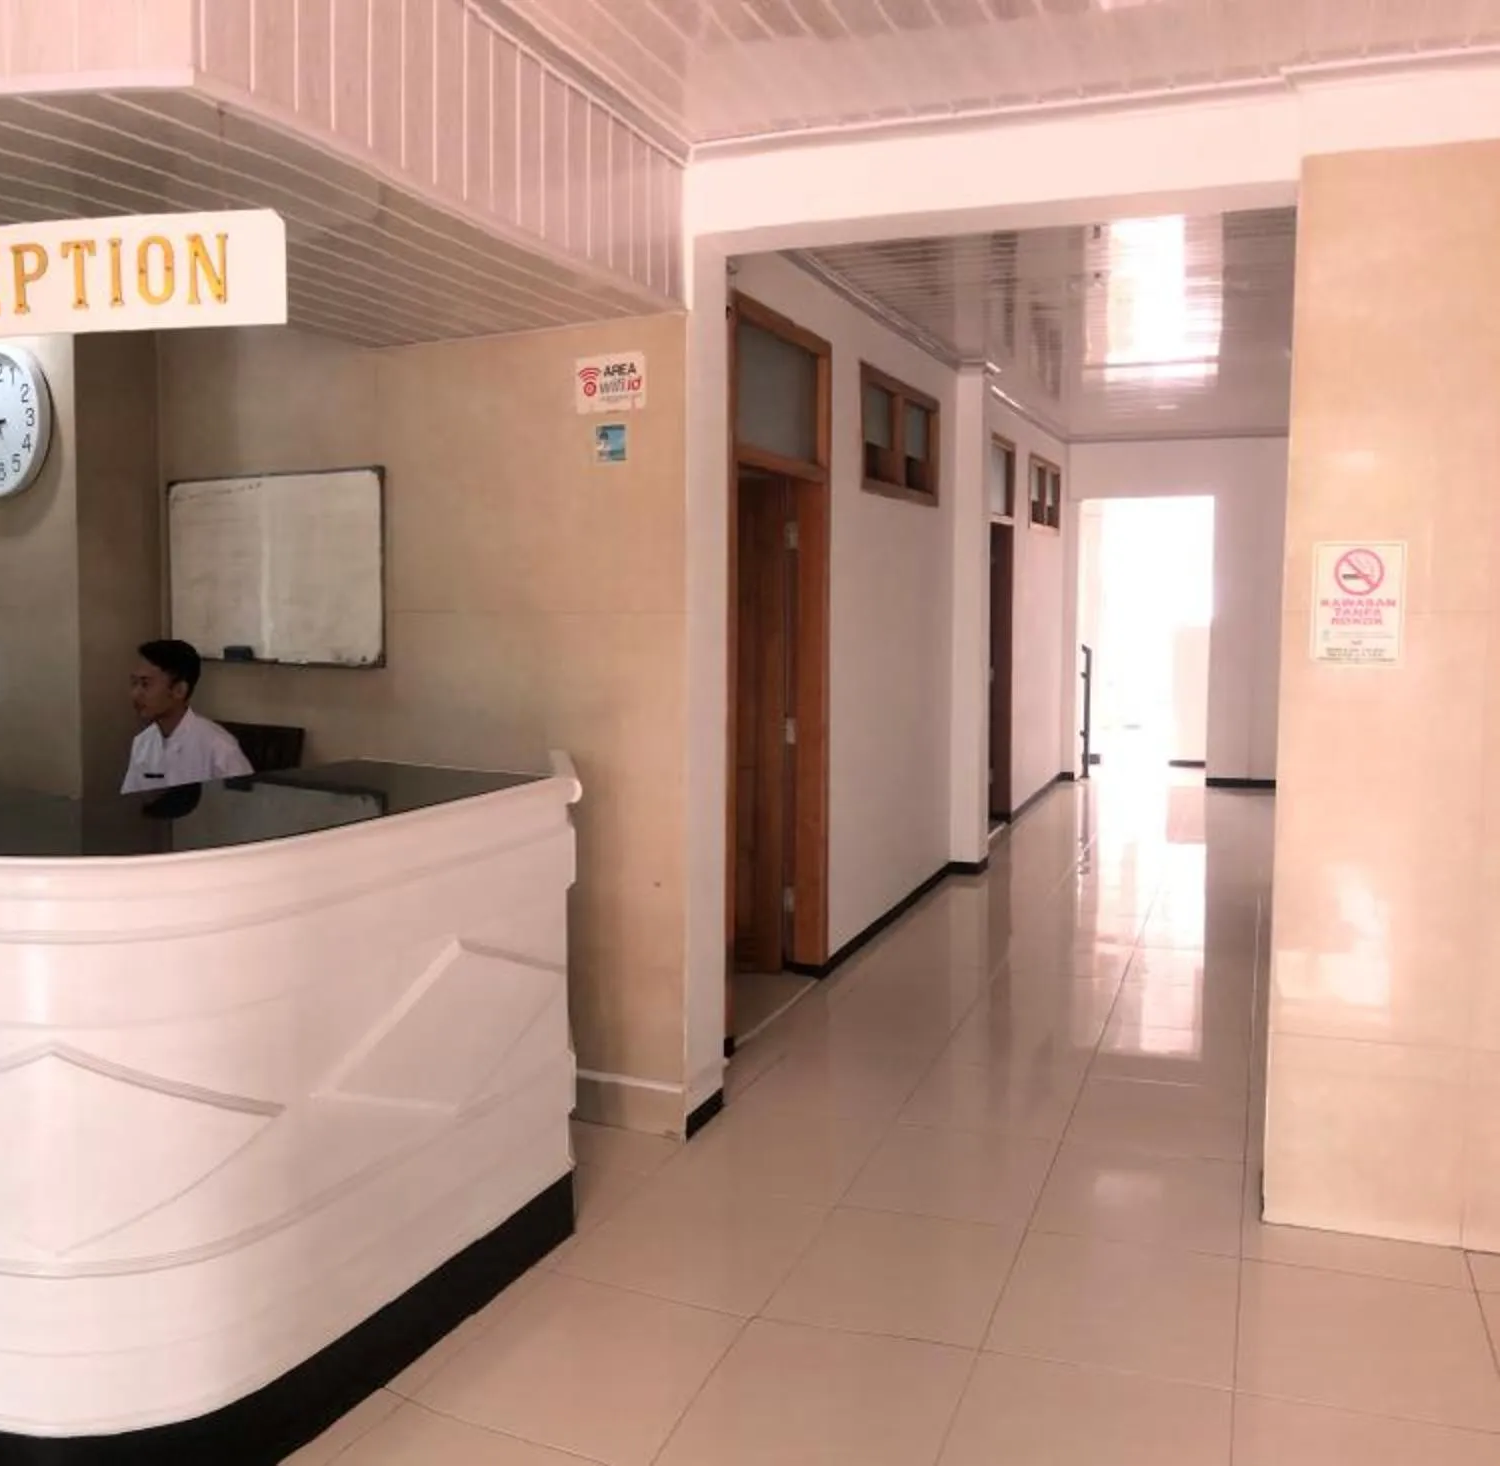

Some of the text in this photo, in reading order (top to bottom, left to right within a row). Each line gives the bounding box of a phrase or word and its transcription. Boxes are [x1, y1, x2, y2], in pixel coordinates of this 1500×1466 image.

[603, 362, 637, 377] AREA
[20, 383, 30, 403] 2
[25, 407, 35, 427] 3
[21, 433, 32, 454] 4
[11, 453, 21, 473] 5
